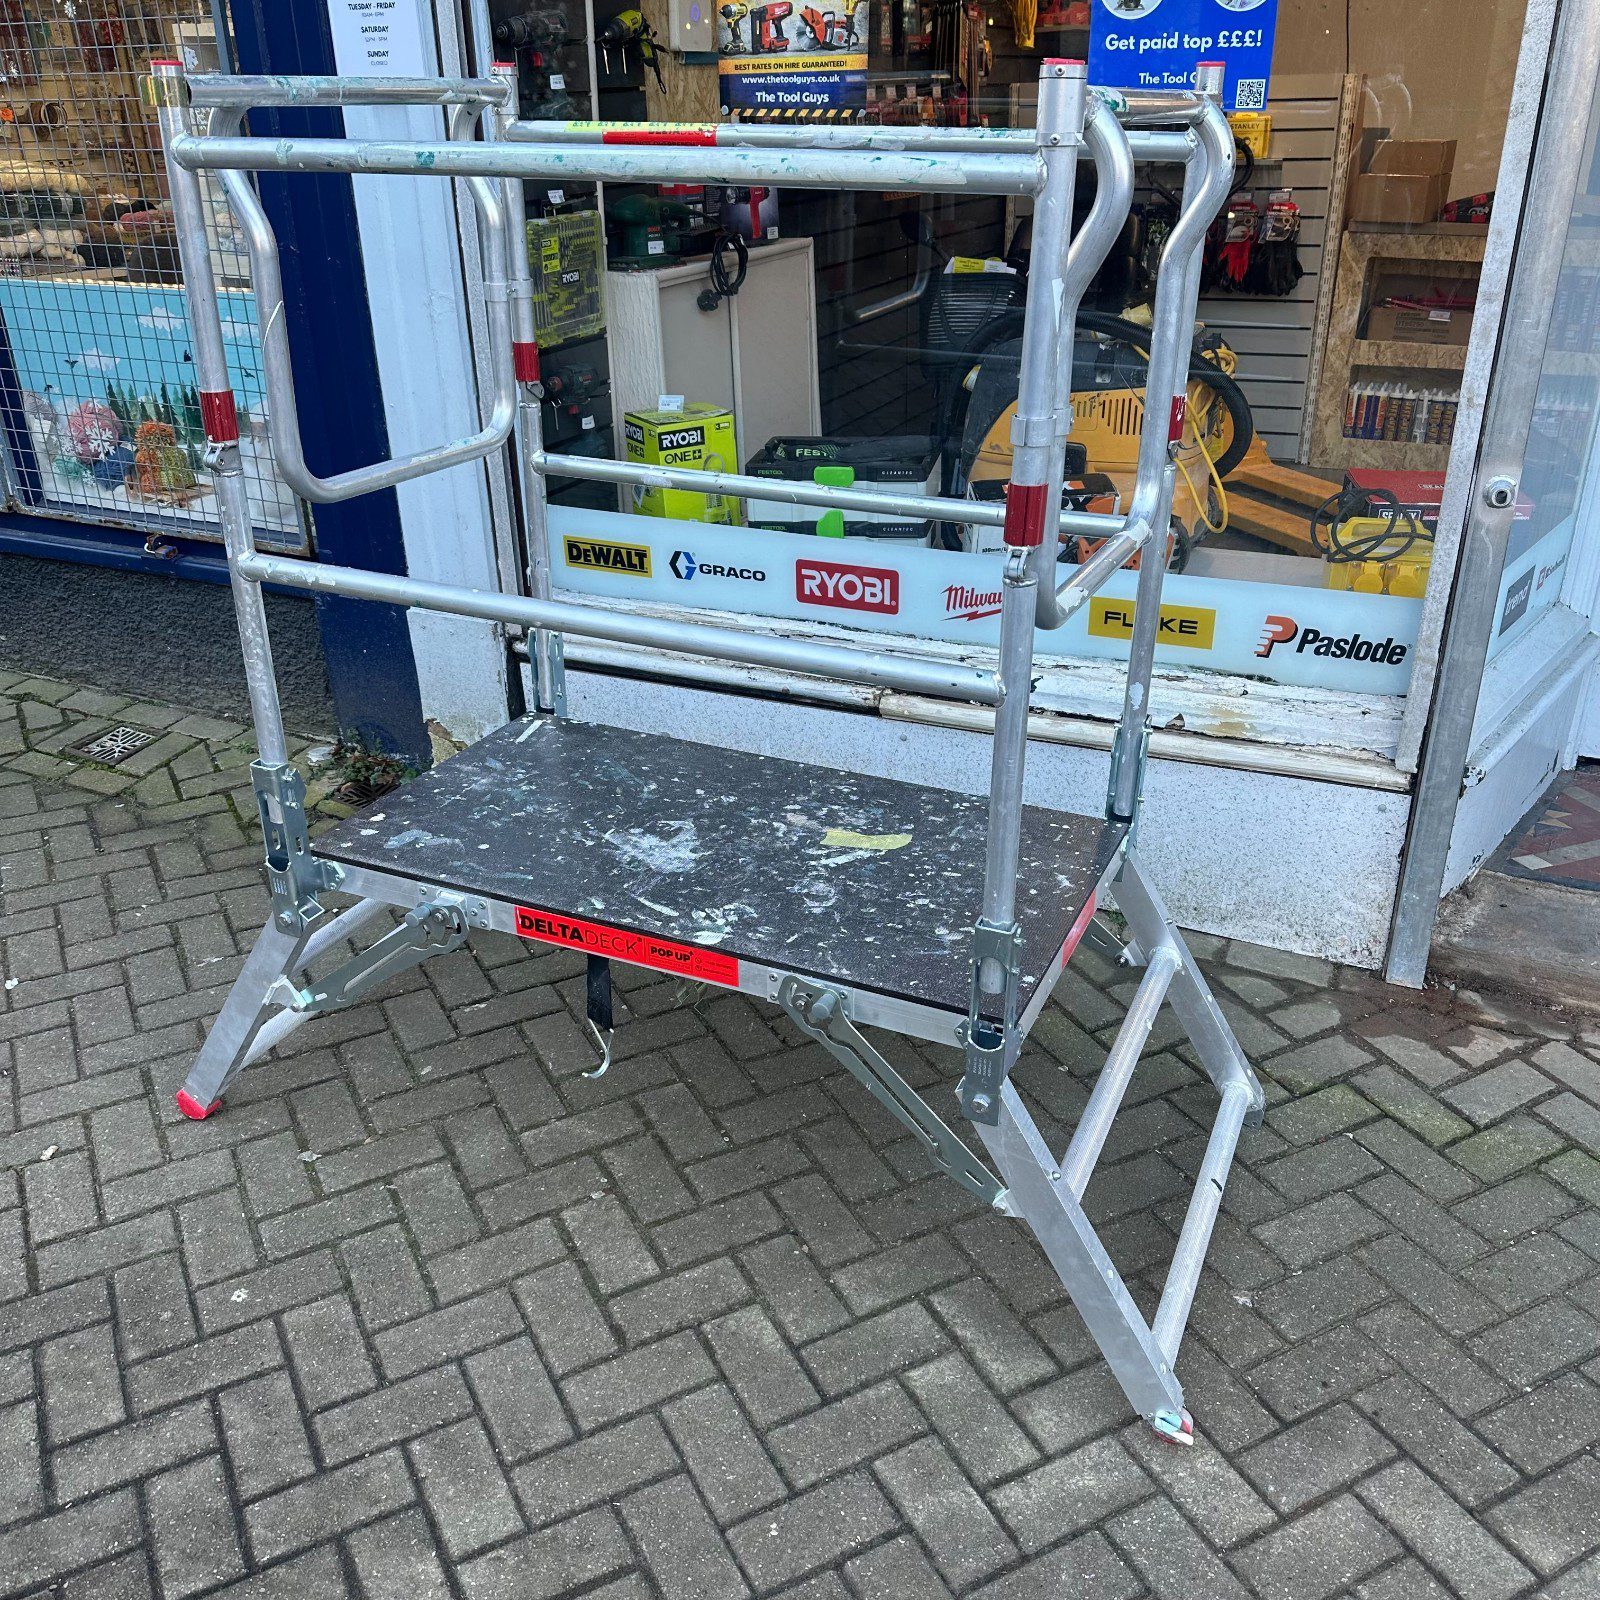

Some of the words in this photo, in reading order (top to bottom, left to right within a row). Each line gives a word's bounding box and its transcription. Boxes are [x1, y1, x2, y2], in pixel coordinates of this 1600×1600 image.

[348, 3, 372, 11] TUESDAY
[1105, 33, 1135, 51] Get
[1139, 32, 1179, 54] paid
[1183, 34, 1213, 53] top
[1217, 30, 1263, 48] £££!
[734, 63, 750, 71] BEST
[752, 62, 771, 70] RATES
[785, 61, 800, 69] HIRE
[802, 60, 847, 69] GUARANTEED!
[742, 74, 840, 85] www.thetoolguys.co.uk
[1139, 72, 1160, 84] The
[1162, 71, 1187, 84] Tool
[756, 92, 775, 103] The
[777, 92, 800, 103] Tool
[802, 92, 830, 105] Guys
[625, 424, 643, 442] RYOBI
[661, 430, 701, 448] RYOBI
[699, 563, 766, 582] GRACO
[801, 568, 891, 605] RYOBI
[1104, 611, 1198, 635] FLKE
[1296, 628, 1407, 665] Paslode
[519, 915, 639, 957] DELTADECK
[650, 946, 673, 958] POP
[675, 953, 691, 963] UP
